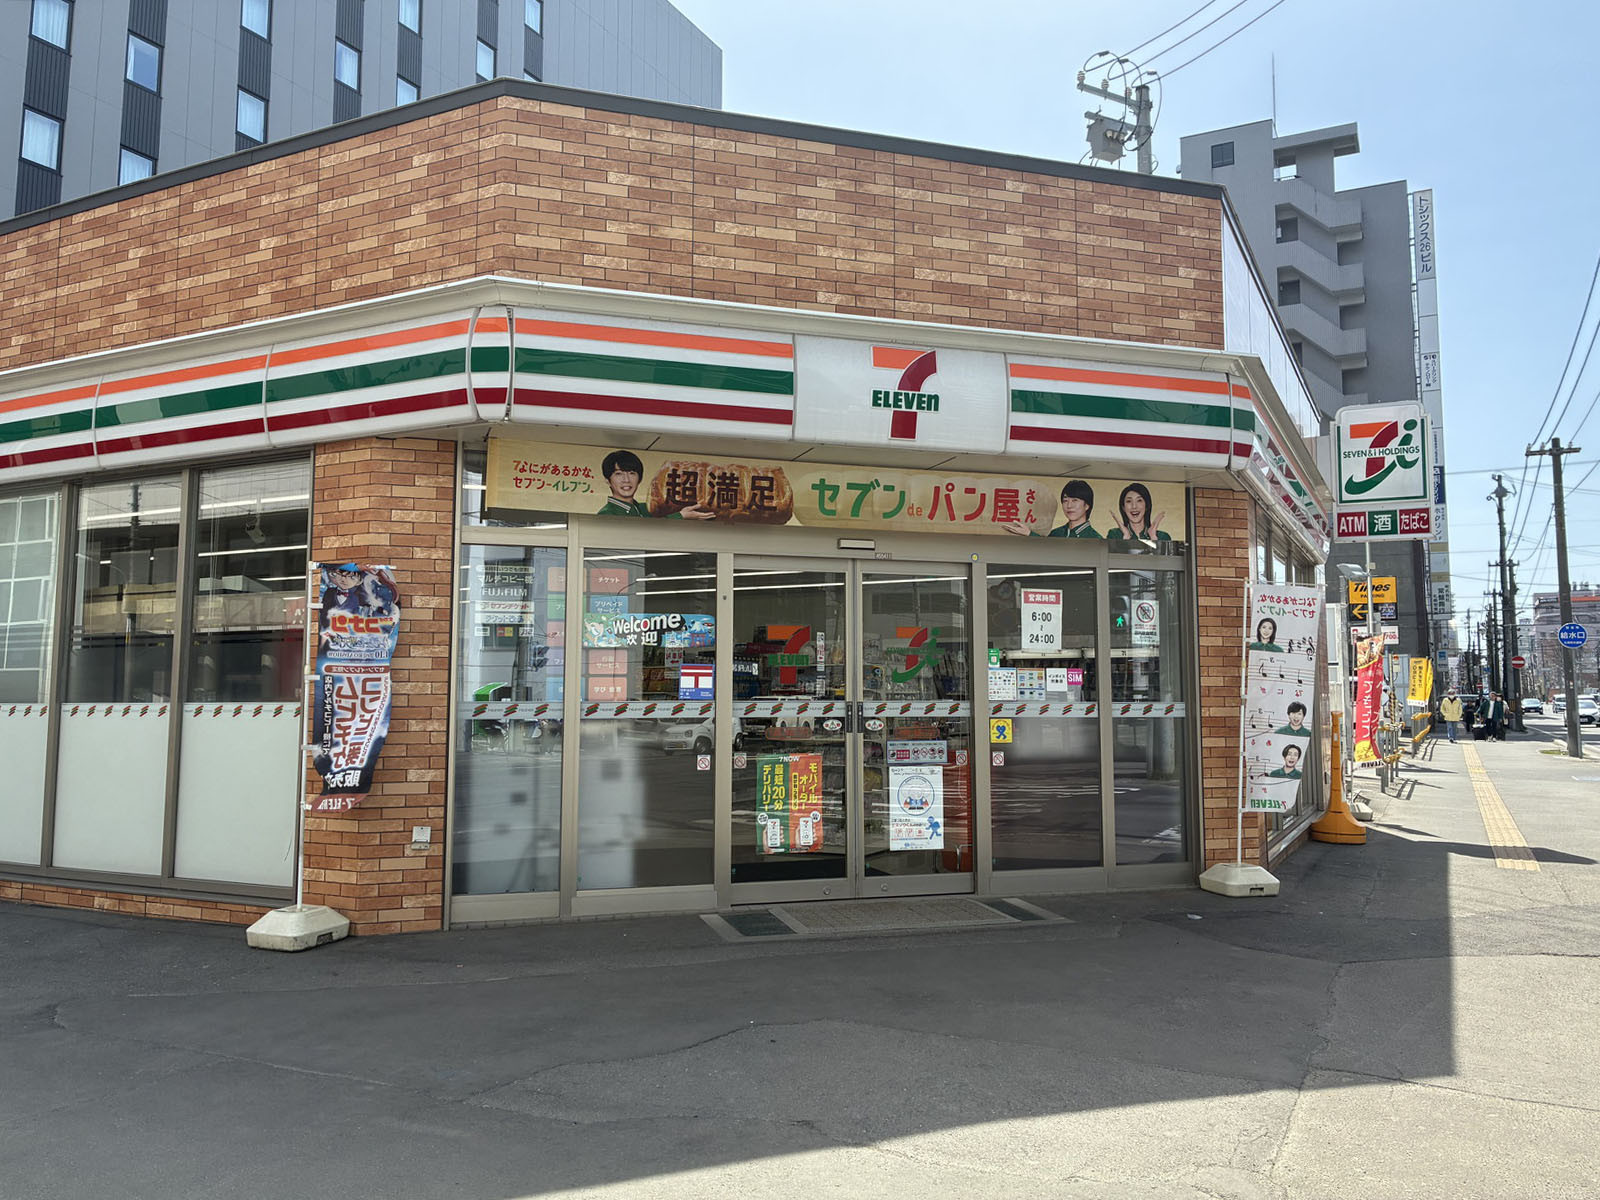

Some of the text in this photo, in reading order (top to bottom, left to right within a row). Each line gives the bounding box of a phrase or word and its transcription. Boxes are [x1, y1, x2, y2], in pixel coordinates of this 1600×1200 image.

[872, 346, 937, 439] 7
[1378, 445, 1420, 456] HOLDINGS
[665, 467, 778, 512] 超満足
[1339, 515, 1365, 533] ATM
[1374, 514, 1392, 532] 酒
[1401, 513, 1429, 530] たばこ
[599, 576, 620, 584] チケット
[613, 613, 681, 634] Welcome
[1032, 612, 1052, 622] 6:00
[626, 631, 658, 646] 欢迎
[1029, 634, 1054, 644] 24:00
[1068, 673, 1082, 682] SIM
[763, 764, 772, 811] デリバリー
[809, 763, 818, 803] モバイル
[800, 775, 808, 810] オーダー
